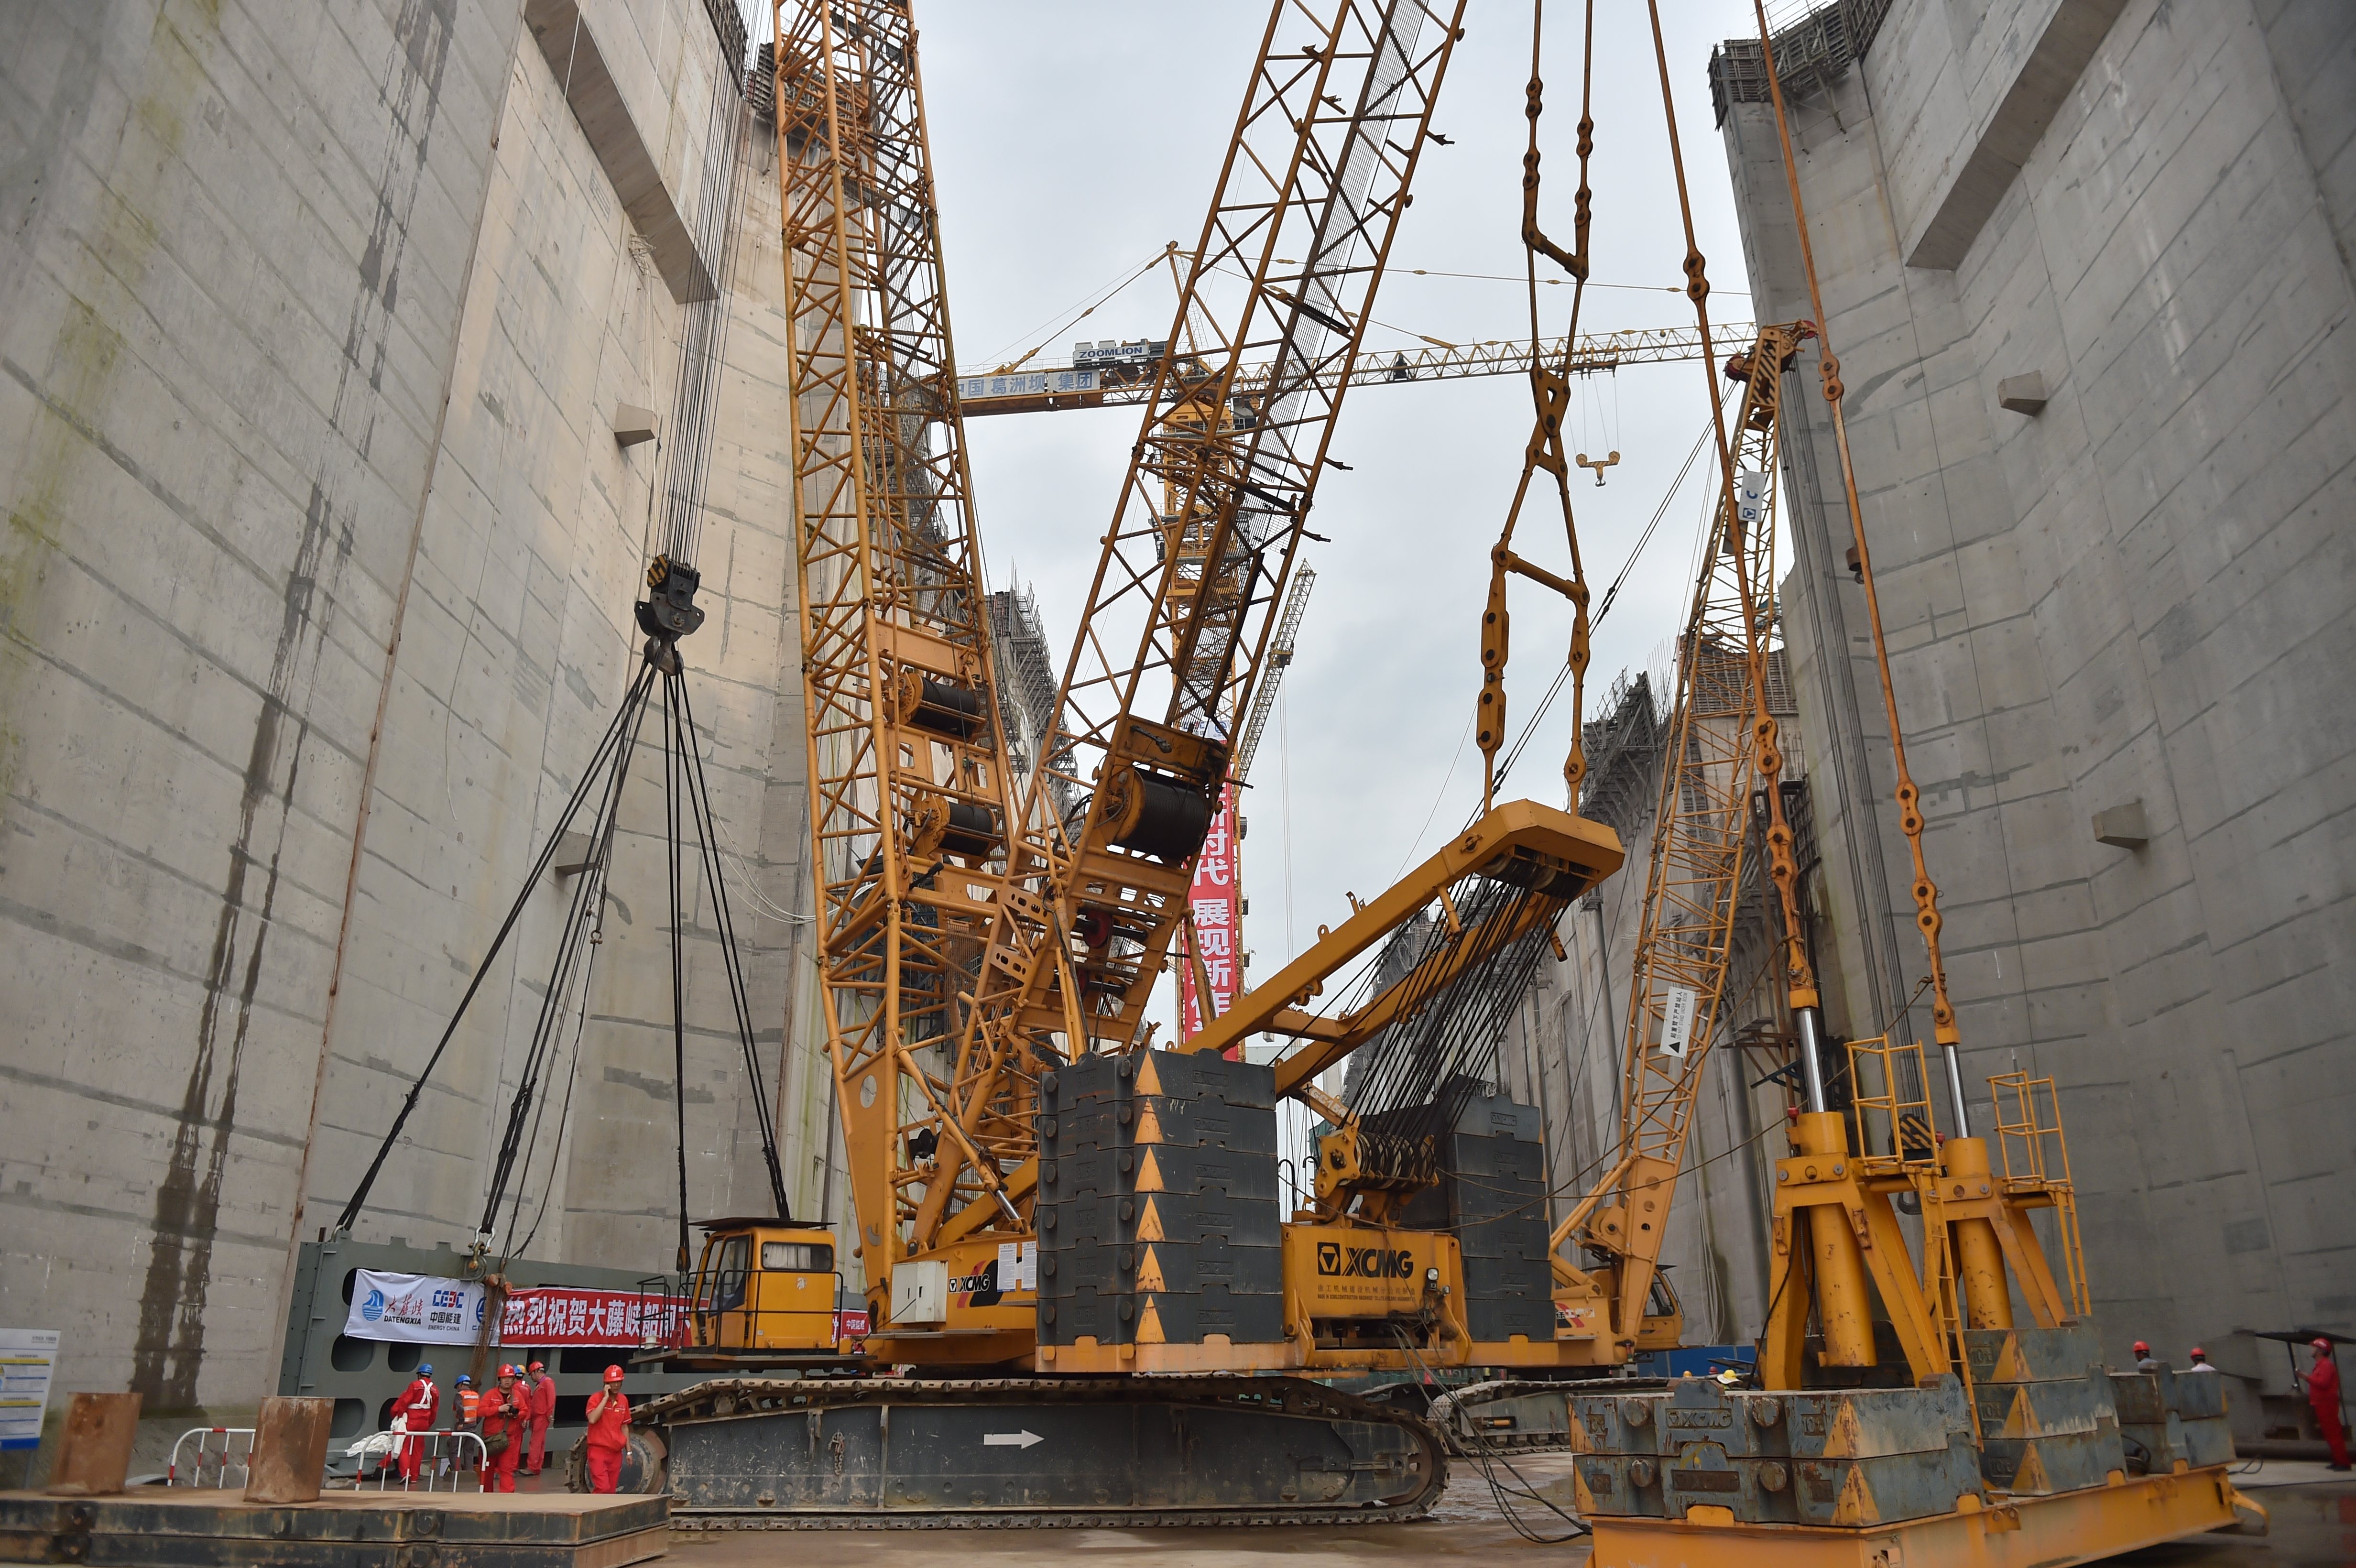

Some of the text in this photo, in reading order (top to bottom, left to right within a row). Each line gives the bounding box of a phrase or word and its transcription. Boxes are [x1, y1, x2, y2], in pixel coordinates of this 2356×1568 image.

[1079, 347, 1143, 359] ZOOMLION
[1342, 1247, 1414, 1279] XCMG
[958, 1274, 990, 1292] XCMG
[384, 1316, 421, 1325] DATENGXIA
[430, 1311, 461, 1325] 中国能建
